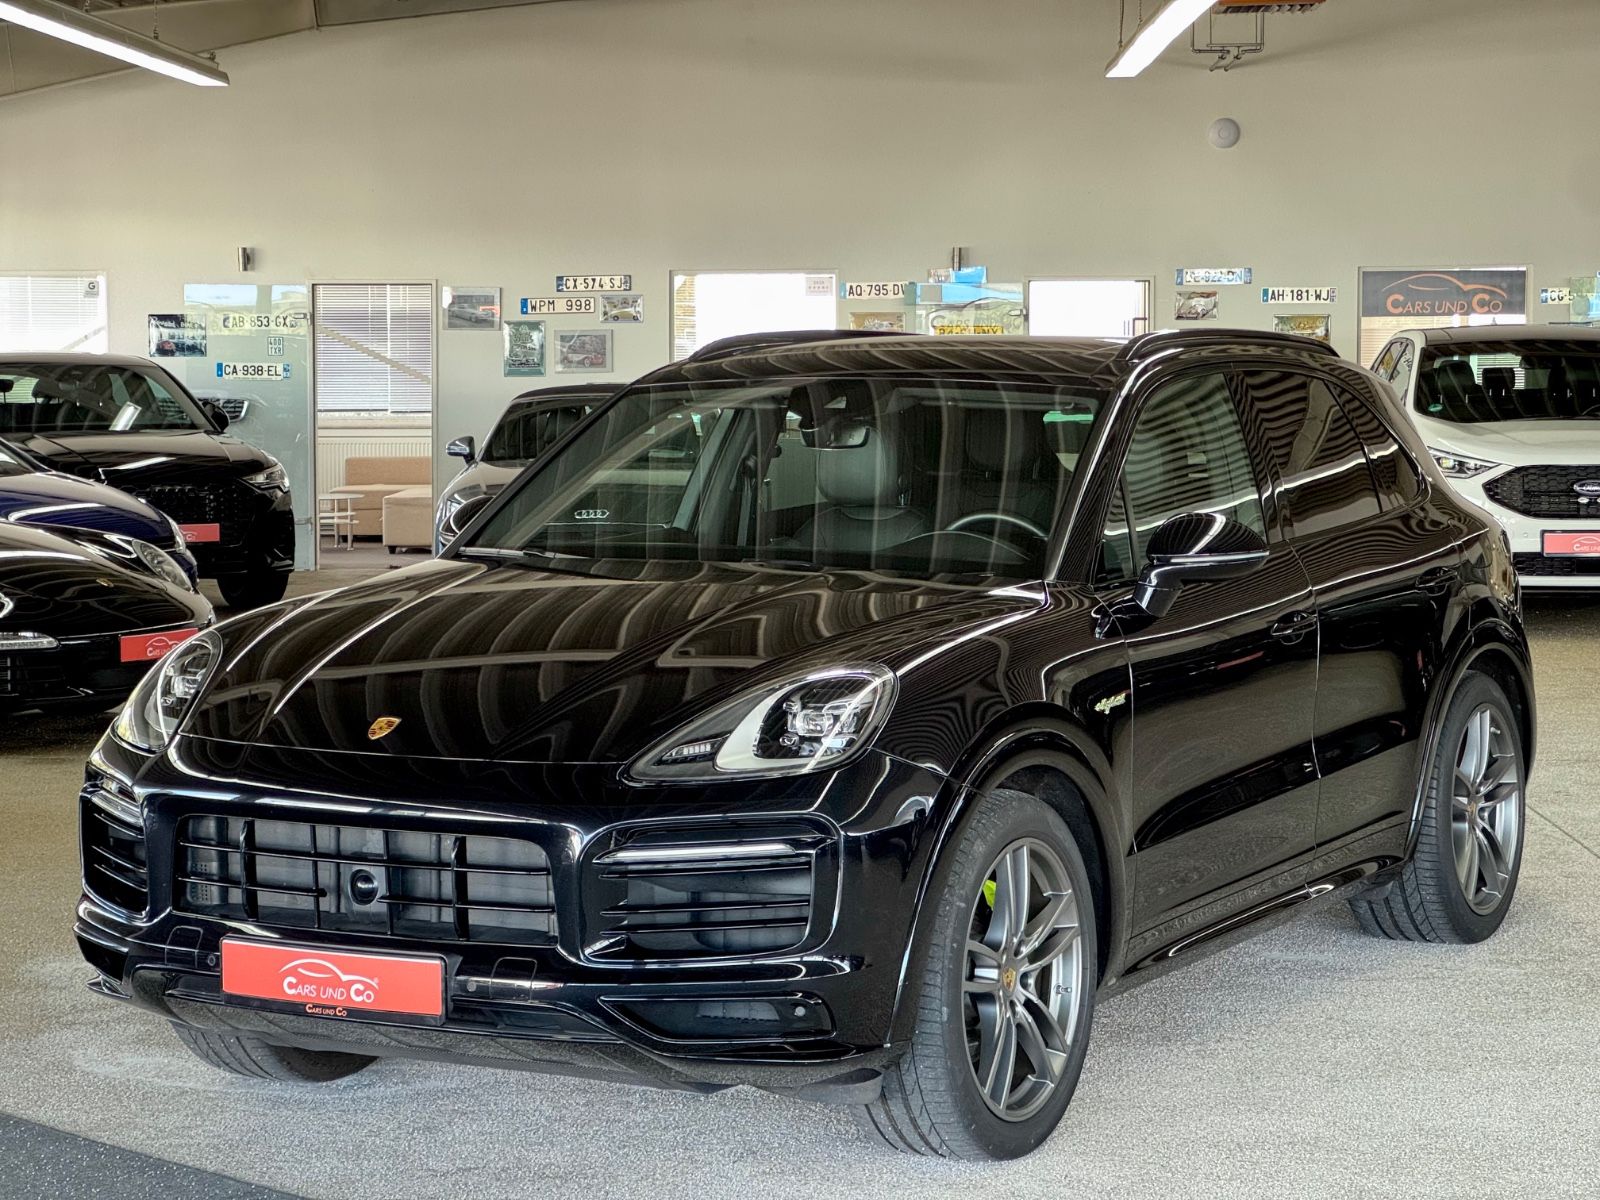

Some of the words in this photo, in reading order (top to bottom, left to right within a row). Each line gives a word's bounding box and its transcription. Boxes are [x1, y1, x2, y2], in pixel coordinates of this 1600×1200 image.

[564, 277, 623, 290] CX-574-SJ
[1269, 289, 1330, 302] AH-181-WJ
[529, 299, 555, 313] WPM
[565, 298, 592, 312] 998
[1434, 300, 1468, 314] UND
[231, 315, 289, 329] AB-853-GX
[223, 364, 282, 376] CA-938-EL
[320, 985, 347, 1001] UND
